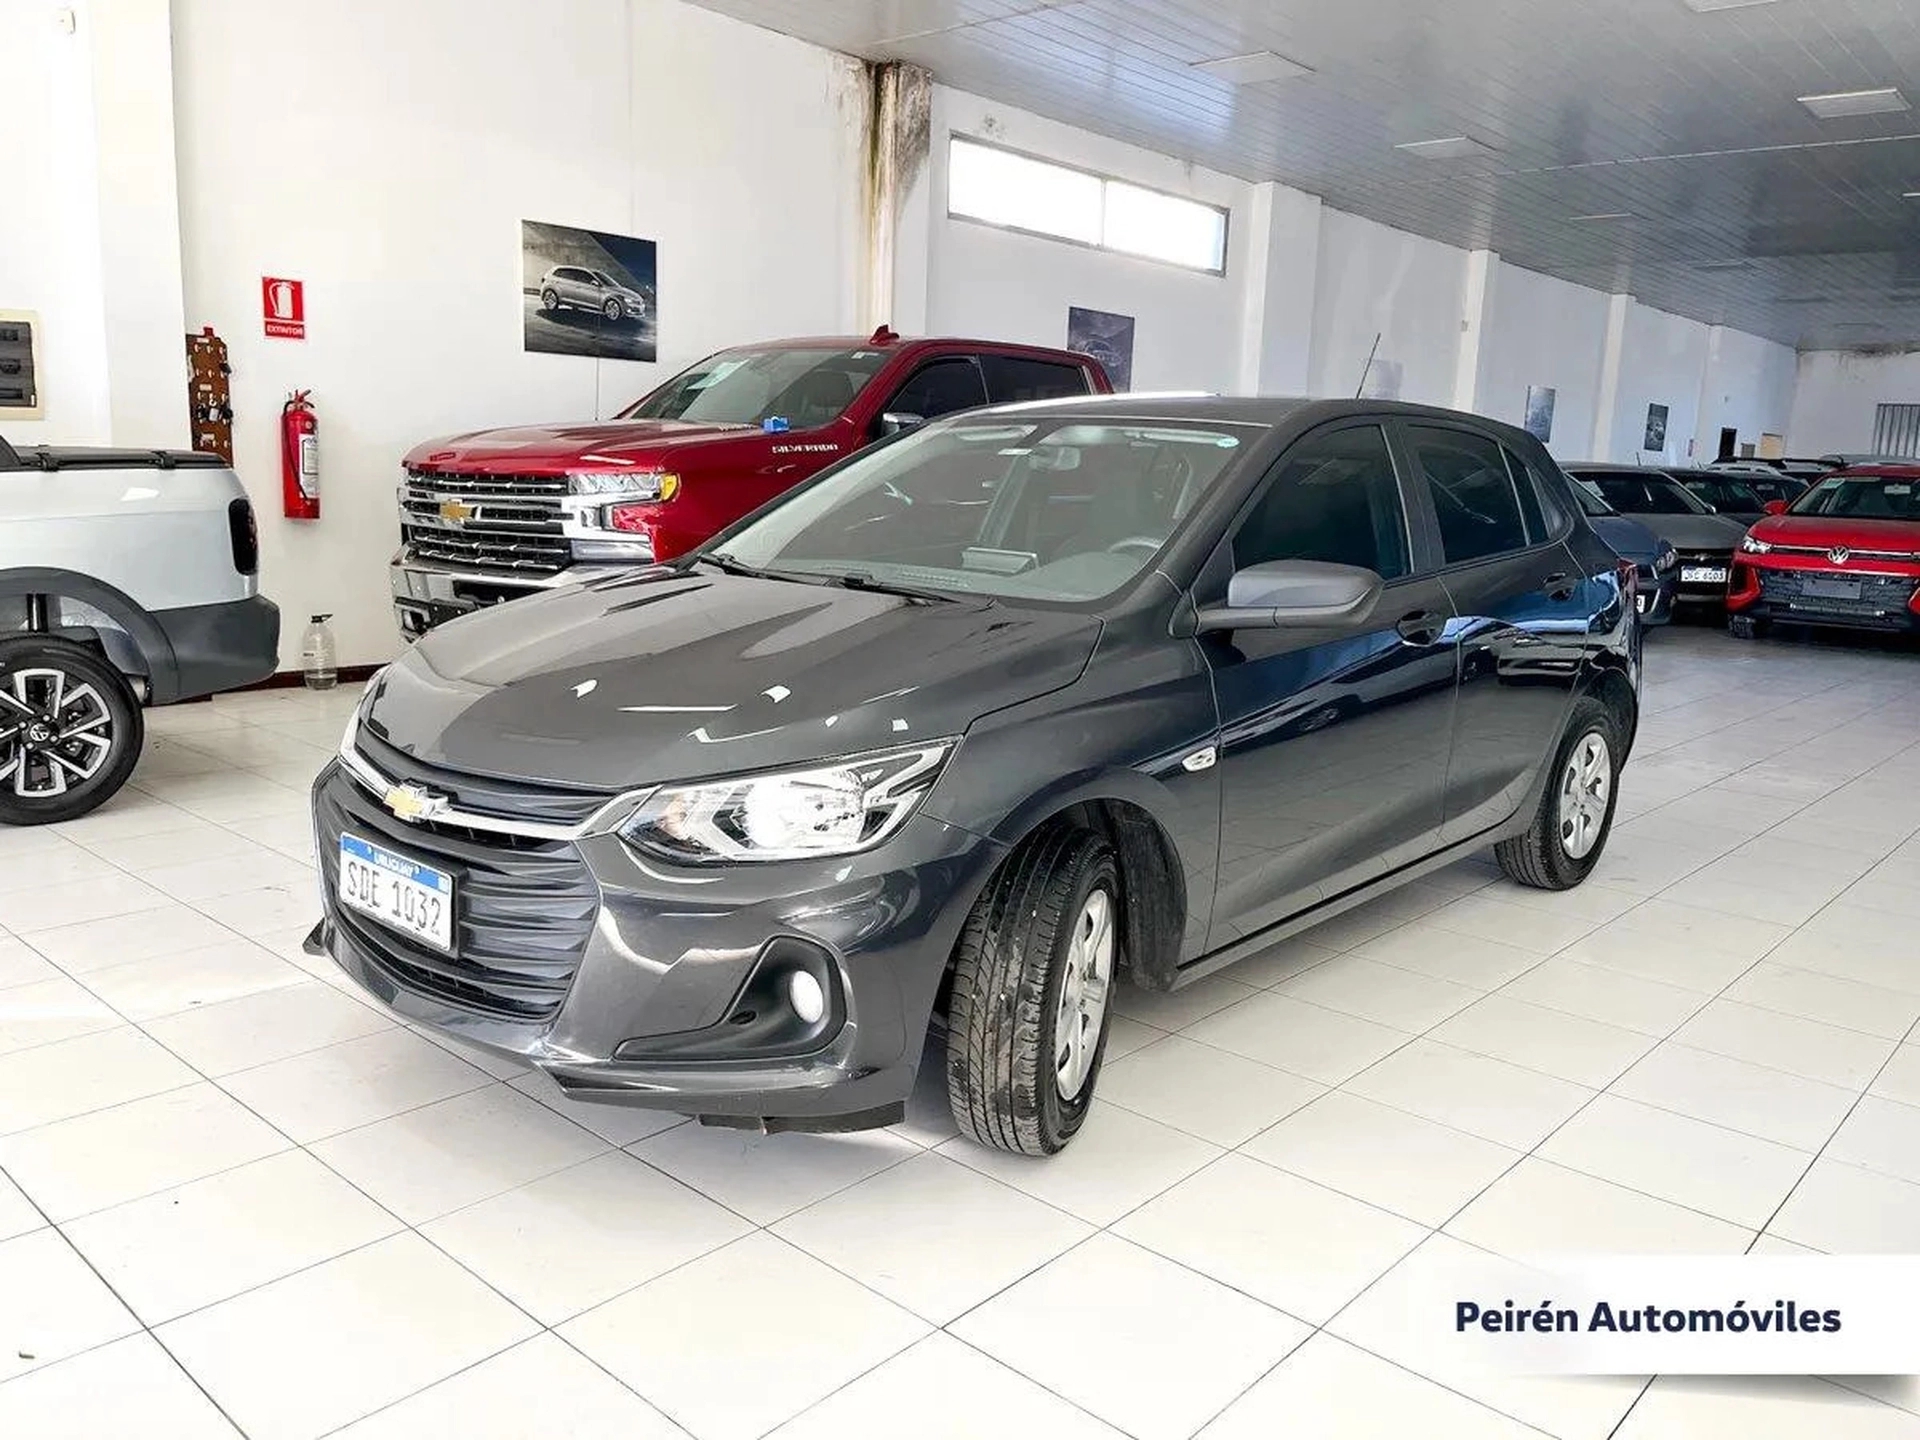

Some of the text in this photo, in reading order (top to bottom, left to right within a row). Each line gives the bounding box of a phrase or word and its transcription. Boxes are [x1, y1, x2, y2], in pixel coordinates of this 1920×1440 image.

[266, 323, 302, 335] EXTINTOR
[772, 443, 839, 454] SILVERADO
[348, 861, 442, 936] SDE 1032
